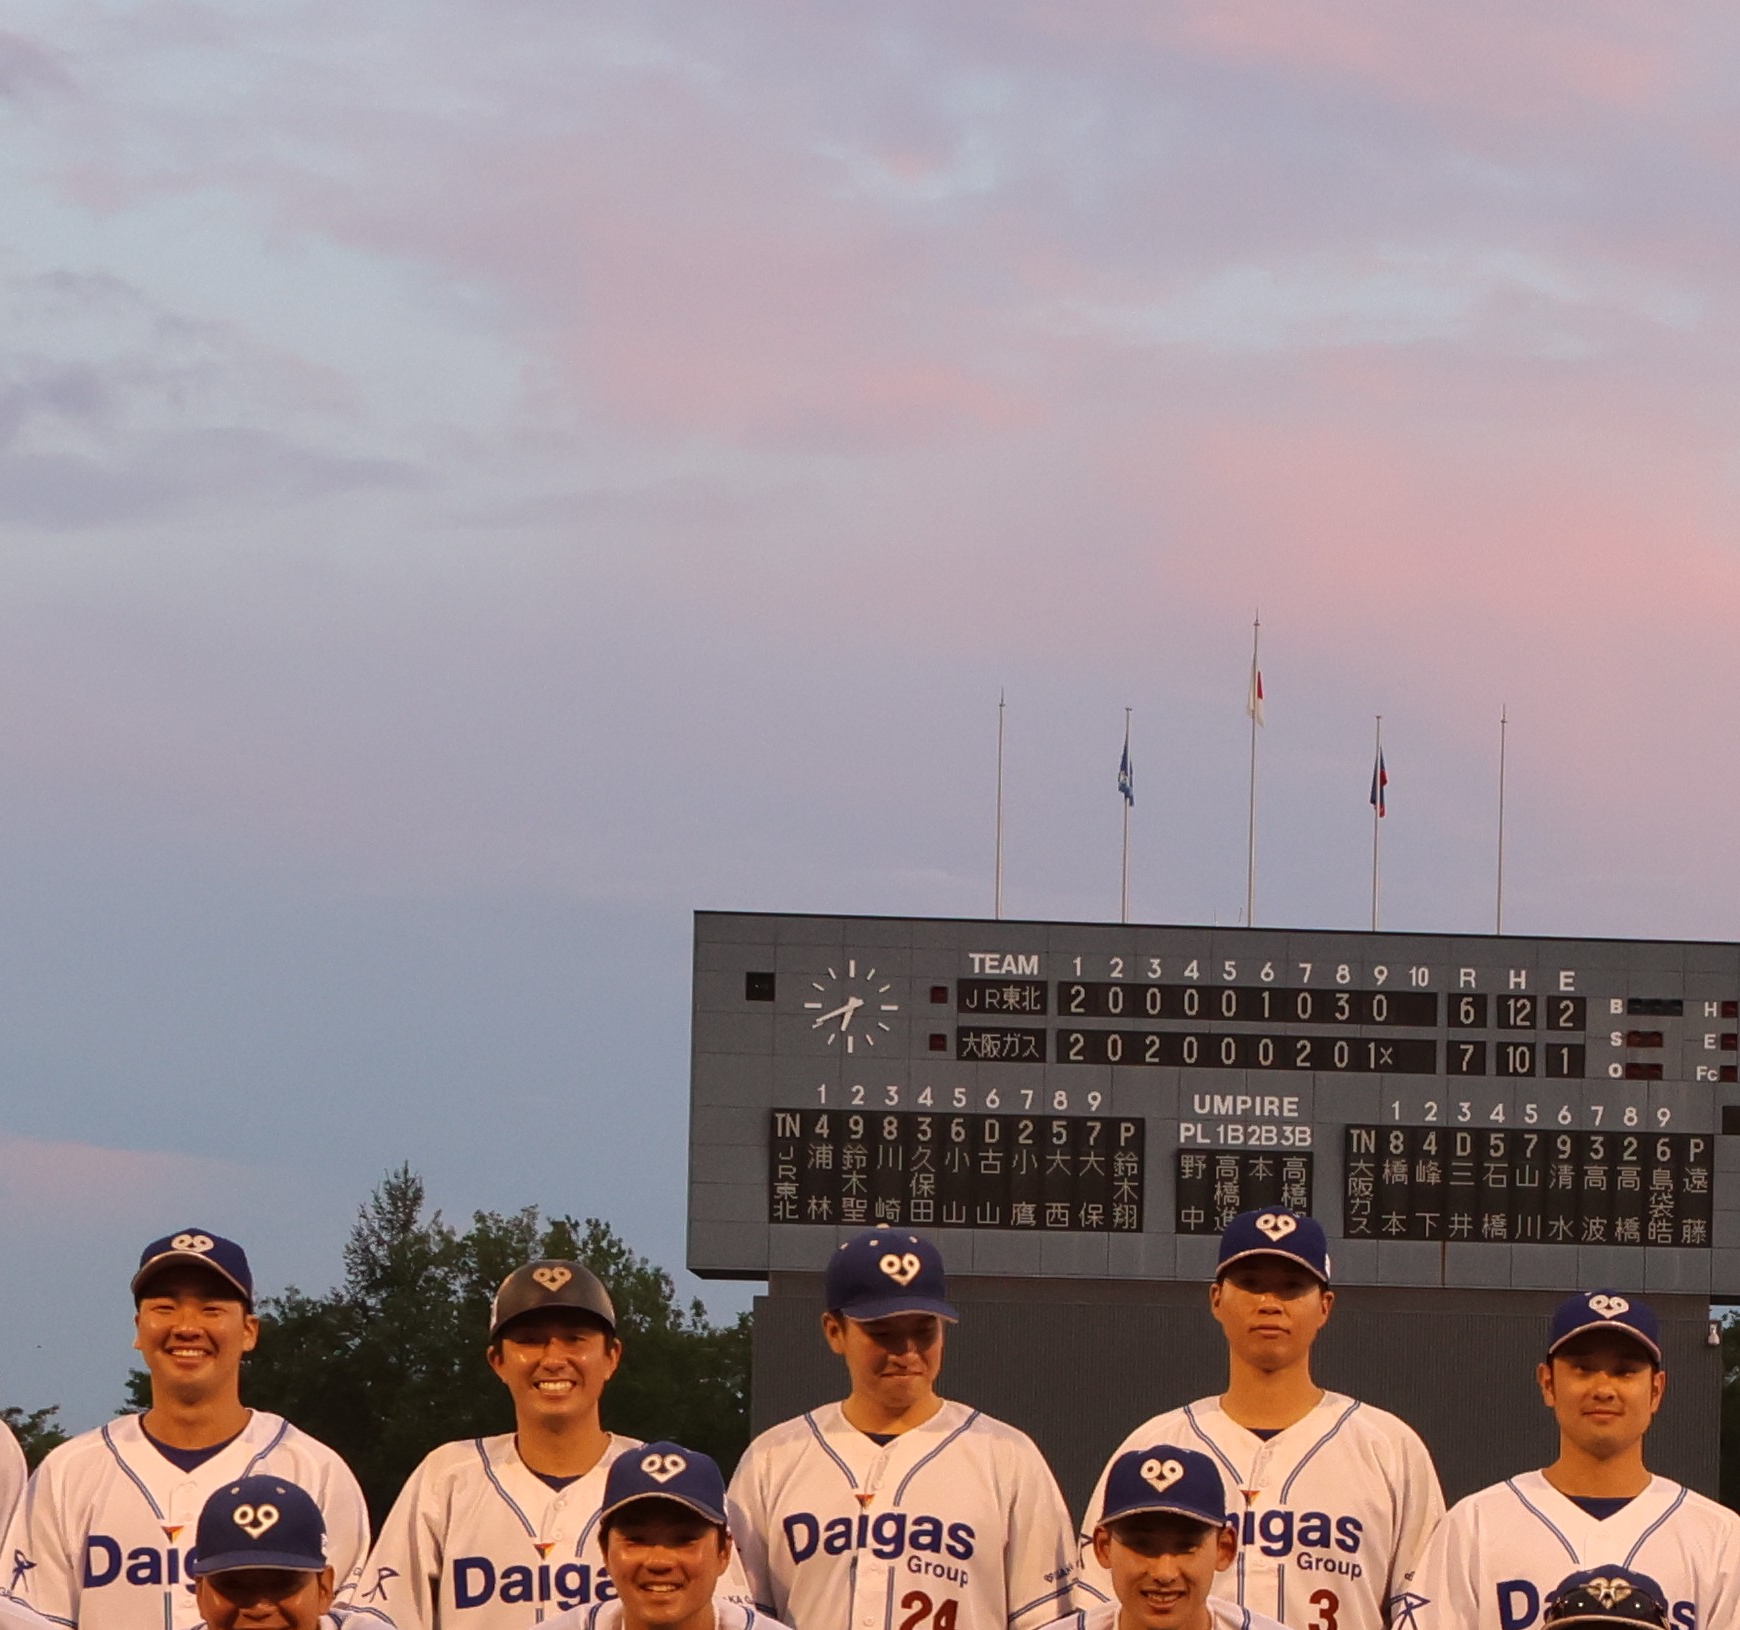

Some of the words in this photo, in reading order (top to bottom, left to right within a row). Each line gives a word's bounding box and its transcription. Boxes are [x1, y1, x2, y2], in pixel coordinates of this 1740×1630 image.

[969, 953, 1040, 976] TEAM
[1073, 957, 1081, 976] 1
[1110, 957, 1123, 978] 2
[1148, 959, 1161, 978] 3
[1184, 960, 1199, 980] 4
[1223, 961, 1236, 981] 5
[1260, 962, 1274, 982] 6
[1299, 963, 1312, 983] 7
[1336, 964, 1350, 984] 8
[1374, 965, 1388, 986] 9
[1409, 966, 1429, 987] 10
[1460, 968, 1476, 988] R
[1509, 969, 1526, 989] H
[1559, 971, 1575, 991] E
[966, 985, 1040, 1011] JR東北
[1071, 985, 1085, 1012] 2
[1109, 987, 1123, 1013] 0
[1146, 988, 1161, 1015] 0
[1184, 989, 1198, 1015] 0
[1222, 990, 1236, 1017] 0
[1262, 991, 1269, 1018] 1
[1298, 992, 1311, 1019] 0
[1335, 993, 1349, 1020] 3
[1373, 994, 1387, 1021] 0
[1460, 997, 1474, 1024] 6
[1507, 998, 1531, 1026] 12
[1559, 1000, 1574, 1027] 2
[1610, 999, 1622, 1014] B
[1704, 1002, 1717, 1017] H
[962, 1032, 1039, 1058] 大阪ガス
[1069, 1033, 1084, 1060] 2
[1108, 1034, 1122, 1061] 0
[1145, 1035, 1159, 1062] 2
[1183, 1036, 1198, 1063] 0
[1221, 1037, 1235, 1064] 0
[1259, 1039, 1273, 1066] 0
[1297, 1040, 1311, 1067] 2
[1334, 1041, 1348, 1068] 0
[1460, 1044, 1474, 1071] 7
[1507, 1046, 1530, 1073] 10
[1561, 1047, 1568, 1074] 1
[1610, 1032, 1622, 1047] S
[1704, 1034, 1716, 1049] E
[1696, 1066, 1718, 1081] Fc
[1194, 1094, 1299, 1117] UMPIRE
[775, 1113, 800, 1137] TN
[815, 1114, 829, 1138] 4
[849, 1115, 863, 1139] 9
[883, 1116, 897, 1140] 8
[917, 1117, 932, 1141] 3
[951, 1118, 965, 1142] 6
[985, 1119, 999, 1143] D
[1019, 1120, 1033, 1144] 2
[1052, 1121, 1067, 1144] 5
[1087, 1122, 1101, 1145] 7
[1120, 1123, 1135, 1146] P
[1180, 1123, 1211, 1143] PL
[1216, 1124, 1244, 1144] 1B
[1247, 1125, 1277, 1145] 2B
[1280, 1126, 1311, 1146] 3B
[1350, 1129, 1375, 1153] TN
[1390, 1131, 1404, 1154] 8
[1423, 1131, 1437, 1155] 4
[1456, 1132, 1470, 1156] D
[1490, 1133, 1504, 1157] 5
[1524, 1134, 1537, 1158] 7
[1557, 1135, 1571, 1159] 9
[1590, 1136, 1604, 1159] 3
[1623, 1137, 1637, 1160] 2
[1657, 1138, 1671, 1161] 6
[1690, 1139, 1704, 1162] P
[783, 1512, 975, 1565] Daigas
[907, 1555, 968, 1589] Group
[1297, 1552, 1362, 1581] Group
[453, 1557, 618, 1611] Daiga
